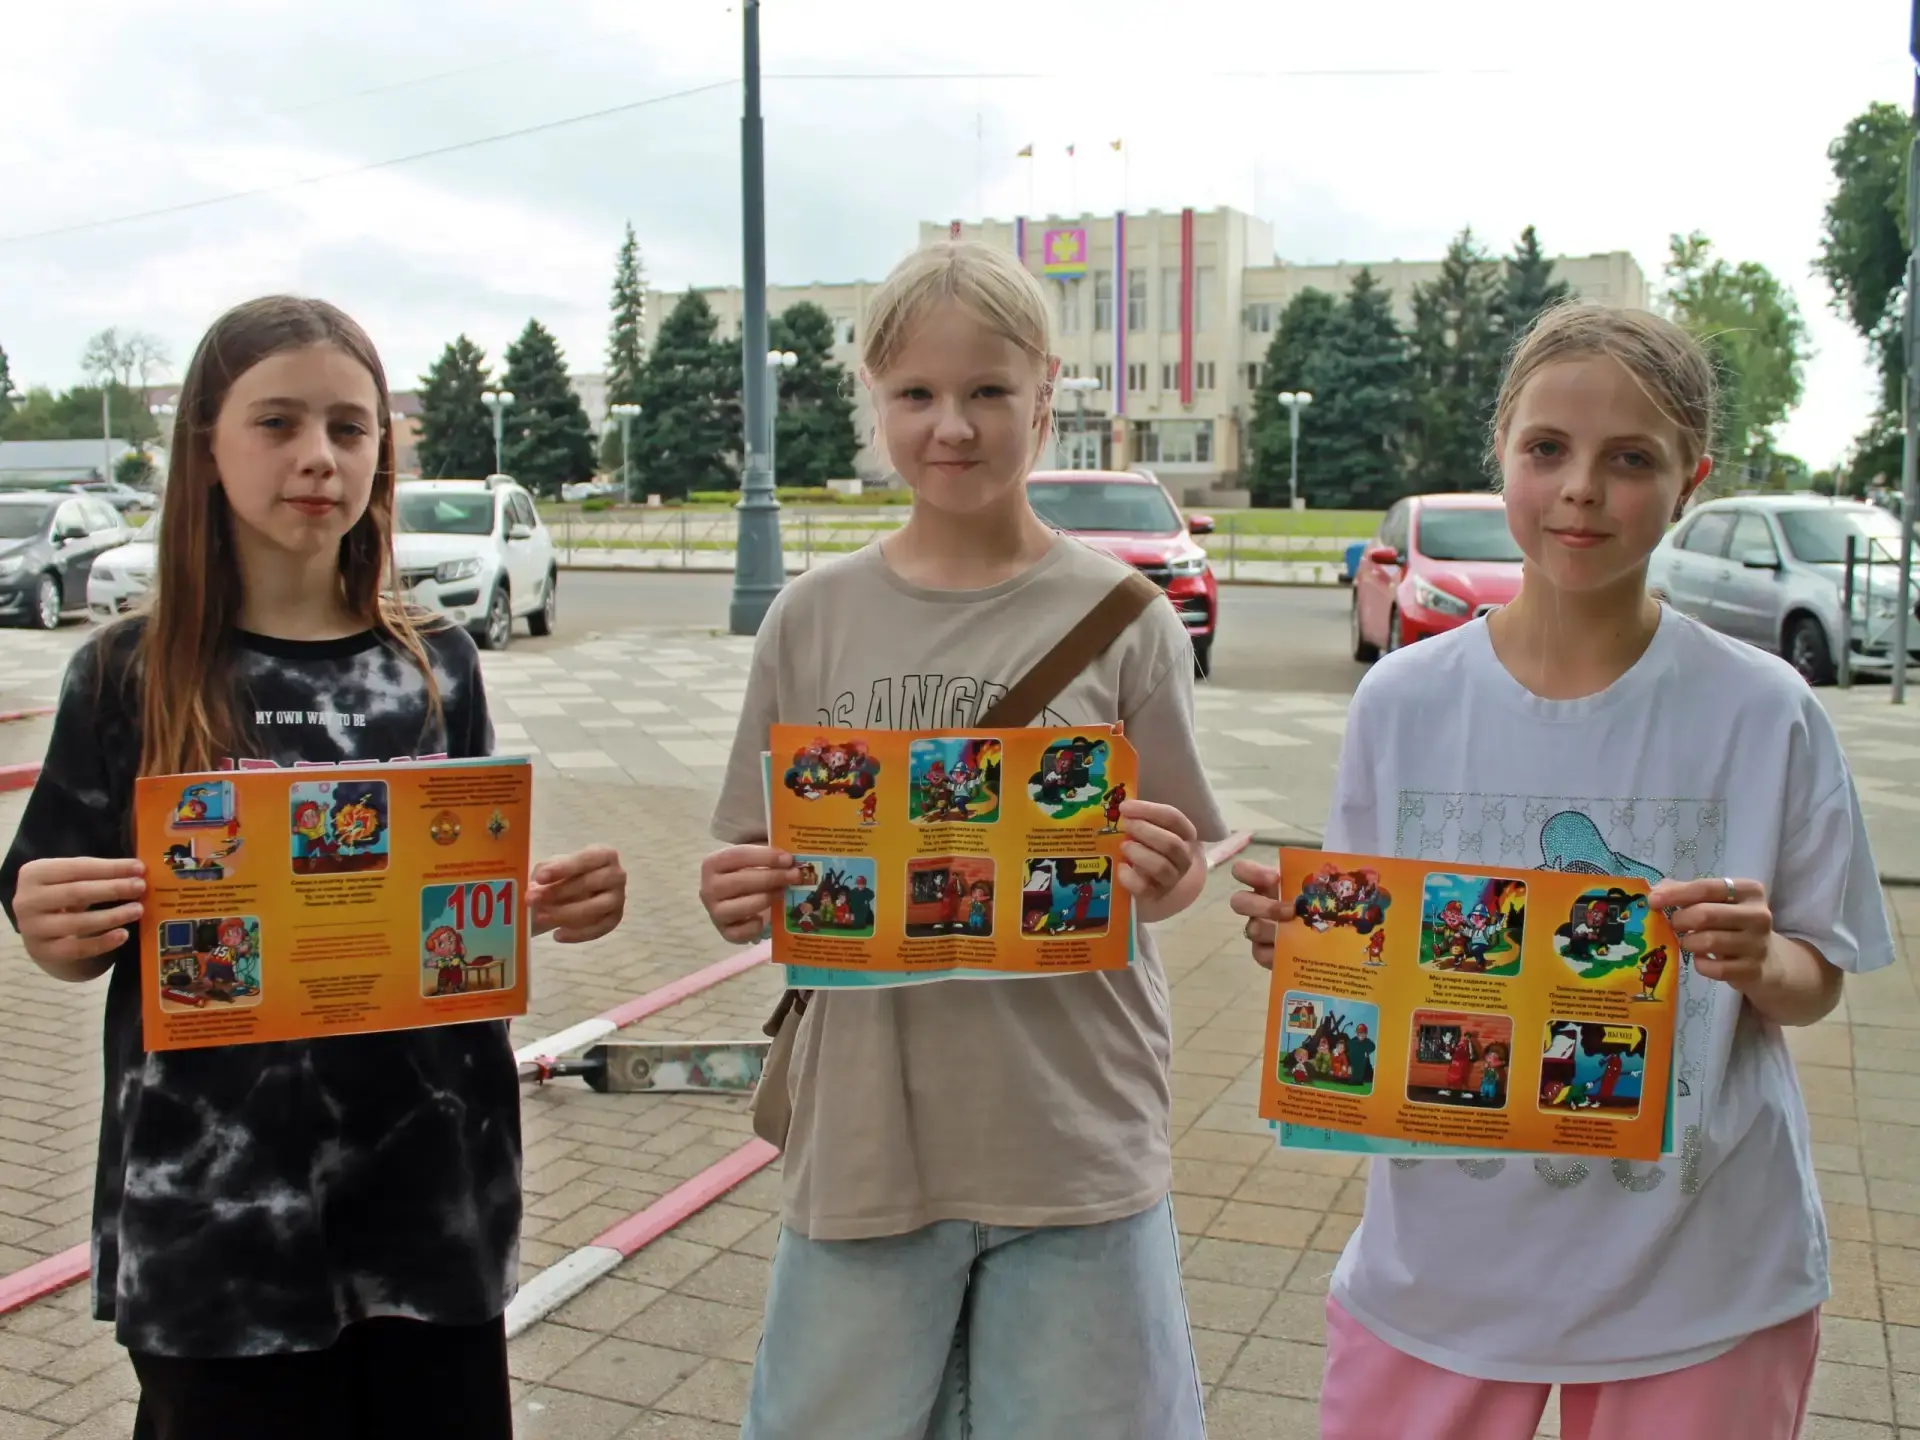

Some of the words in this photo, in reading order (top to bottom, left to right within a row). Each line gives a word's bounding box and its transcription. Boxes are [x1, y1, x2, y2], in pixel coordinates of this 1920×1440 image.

[255, 711, 273, 724] MY
[276, 711, 303, 724] OWN
[339, 713, 350, 726] TO
[352, 713, 366, 727] BE
[447, 881, 513, 931] 101
